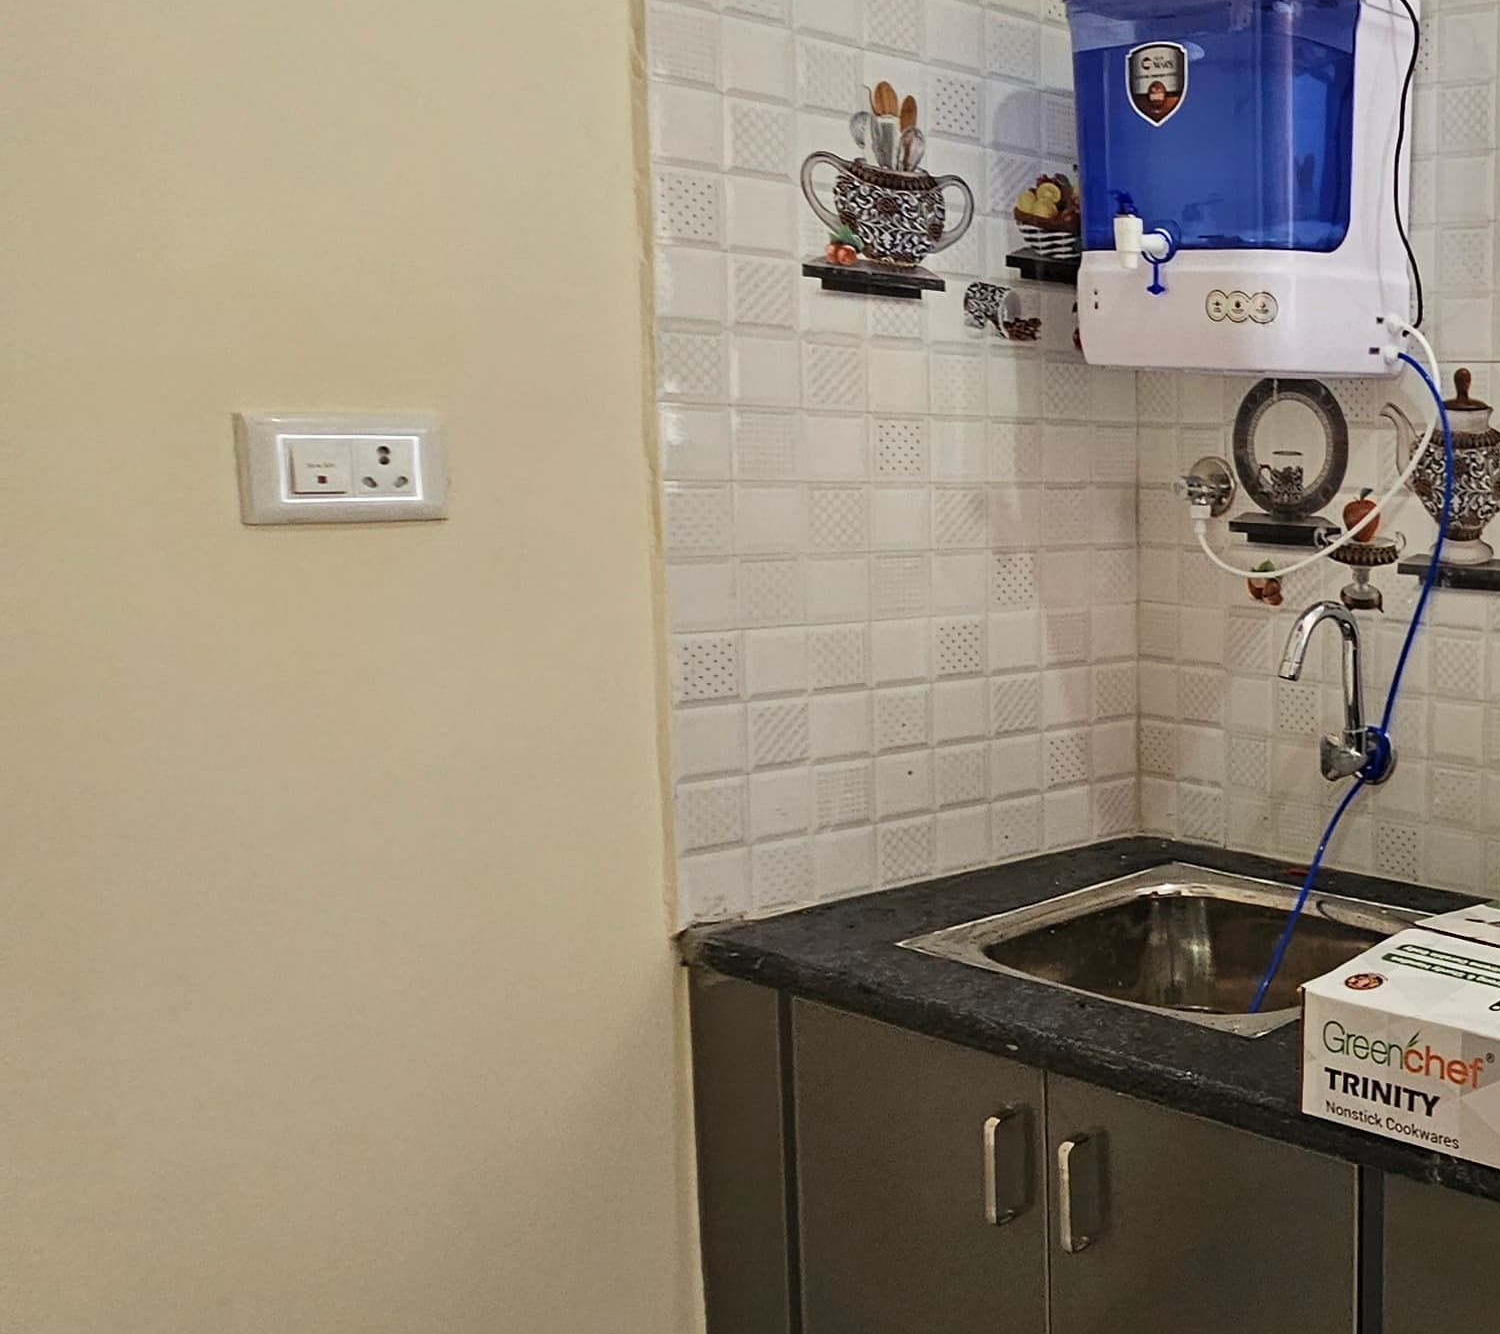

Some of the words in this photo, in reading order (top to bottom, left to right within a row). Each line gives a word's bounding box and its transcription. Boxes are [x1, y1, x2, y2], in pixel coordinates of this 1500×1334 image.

[1323, 1020, 1484, 1089] Greenchef
[1324, 1067, 1441, 1118] TRINITY
[1325, 1099, 1383, 1128] Nonstick
[1386, 1117, 1460, 1150] Cookwares
